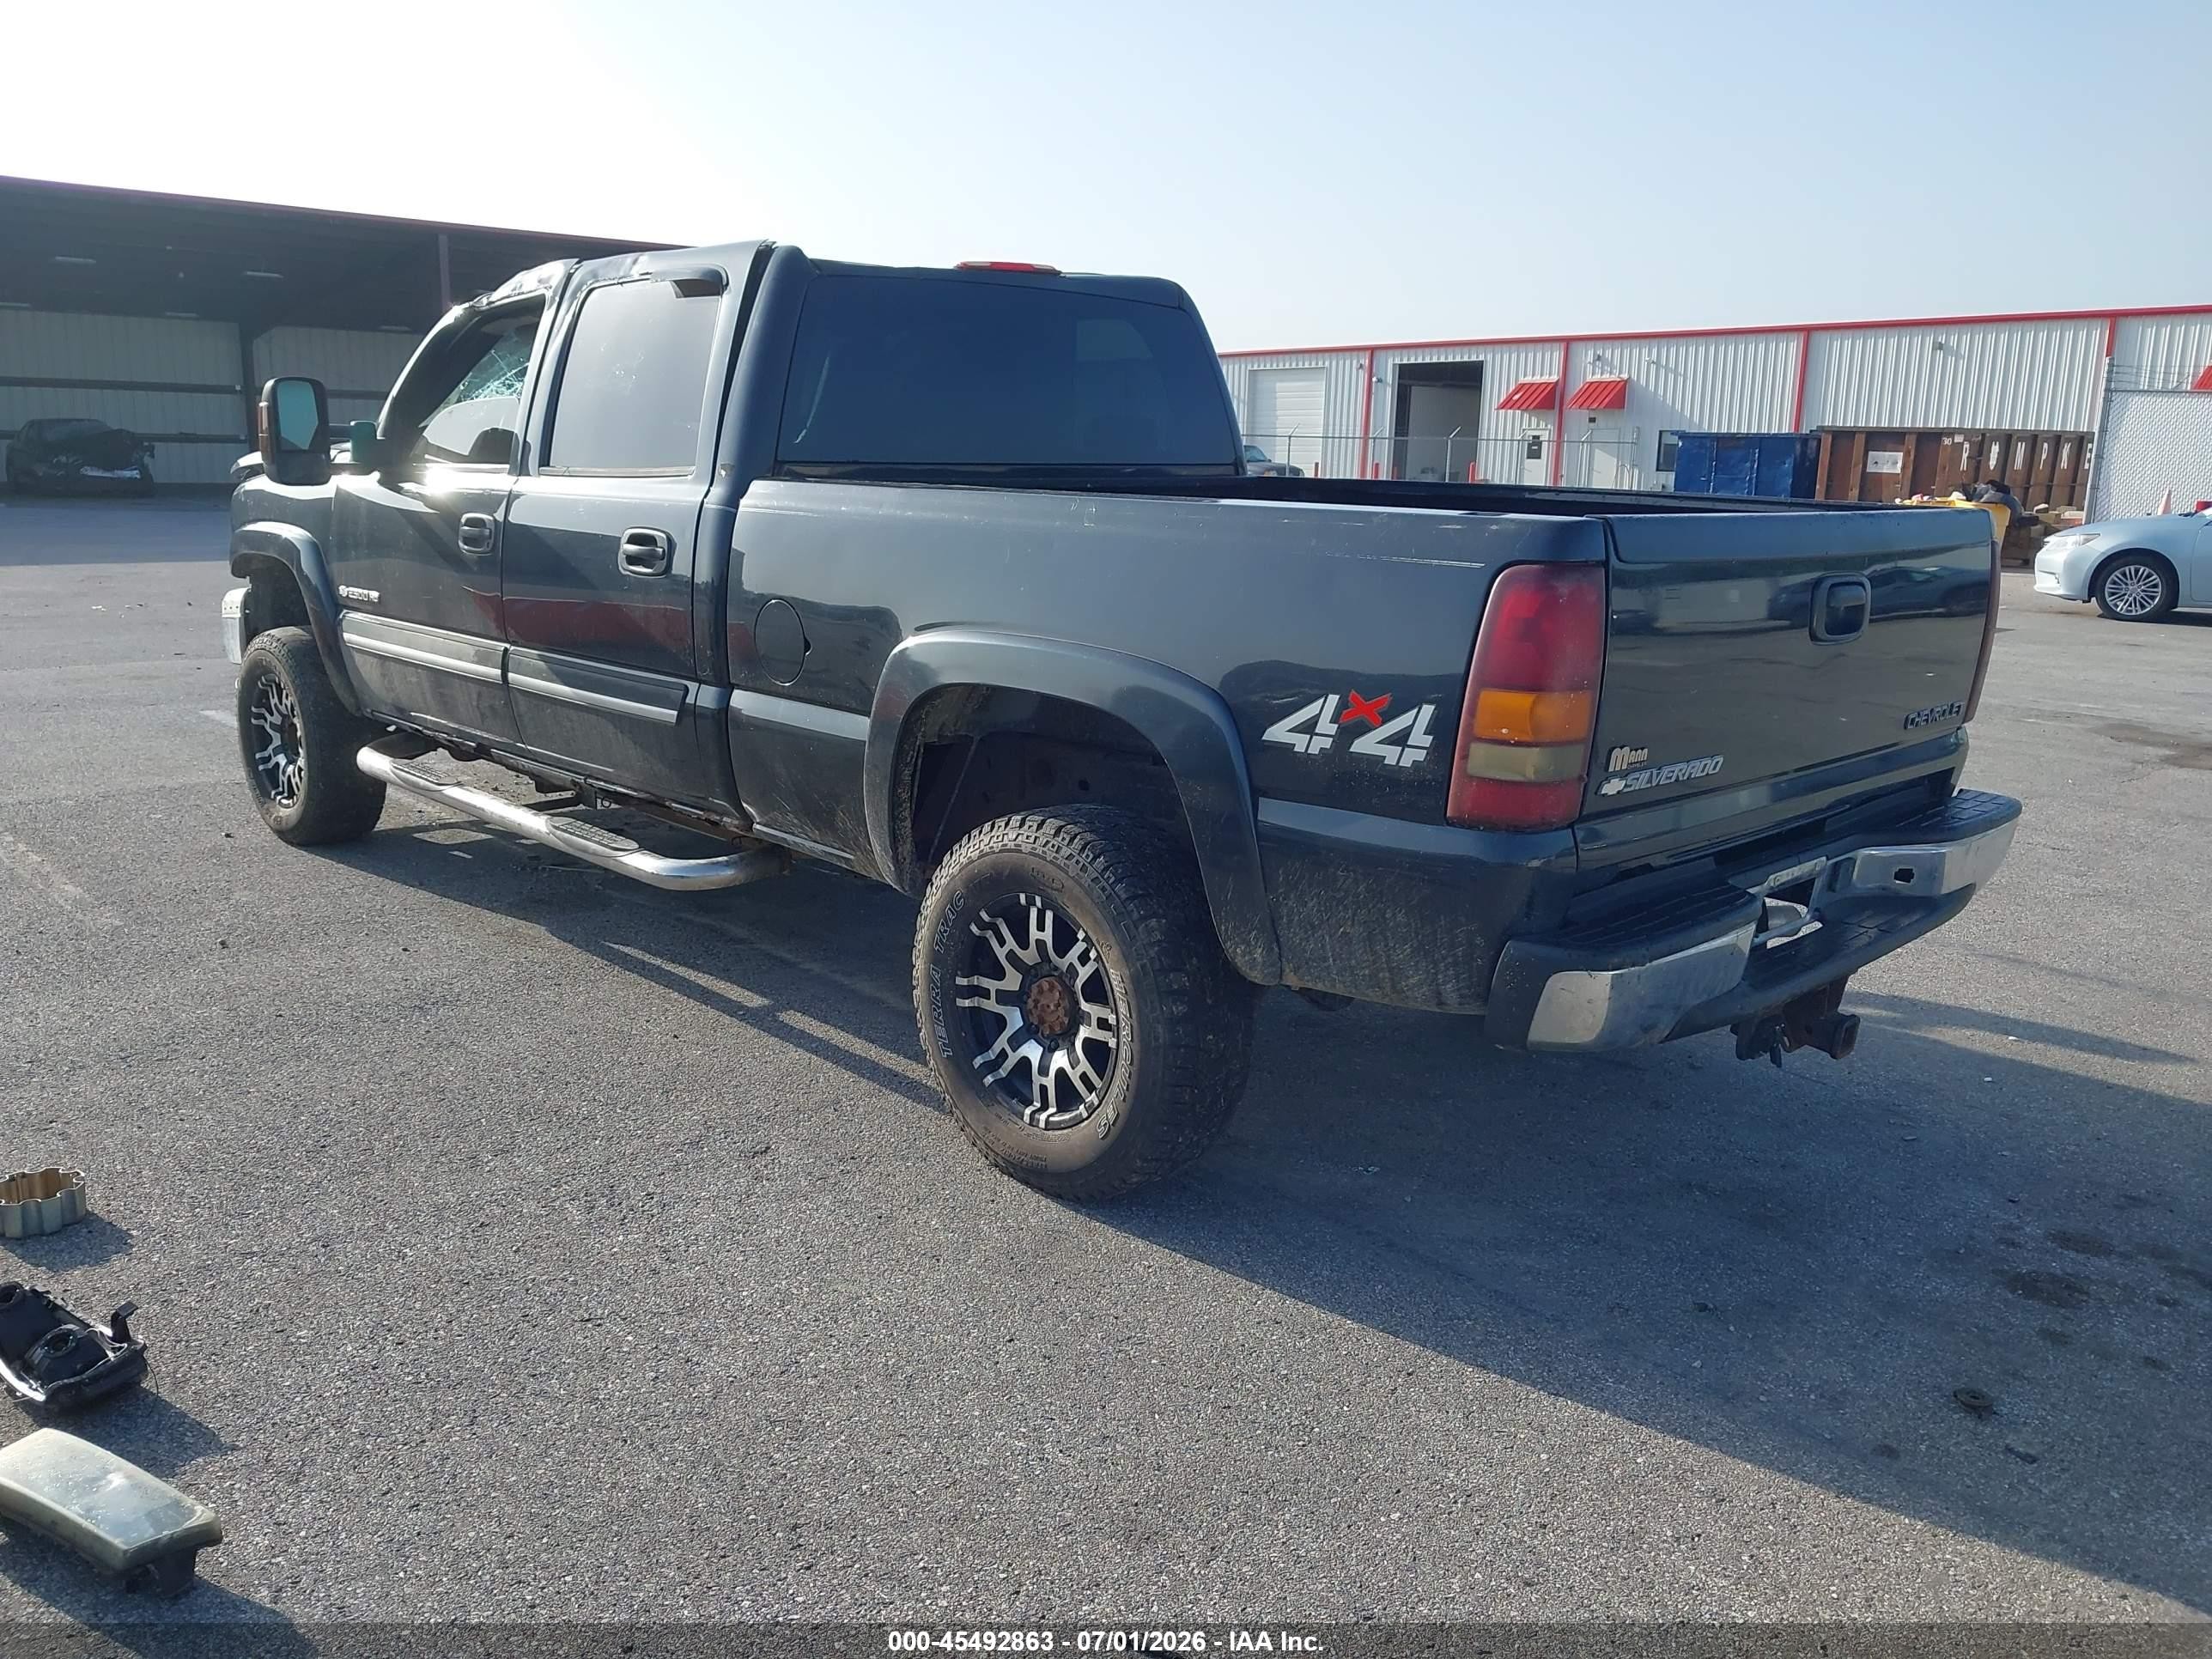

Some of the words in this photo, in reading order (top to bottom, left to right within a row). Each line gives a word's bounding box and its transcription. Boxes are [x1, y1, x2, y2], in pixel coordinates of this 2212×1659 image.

[1942, 437, 1953, 446] 30
[1906, 701, 1966, 729] CHEVROLET
[1622, 755, 1724, 793] SILVERADO
[934, 890, 965, 954] TRAC
[930, 963, 953, 1059] TERRA
[1096, 968, 1133, 1140] HERCULES
